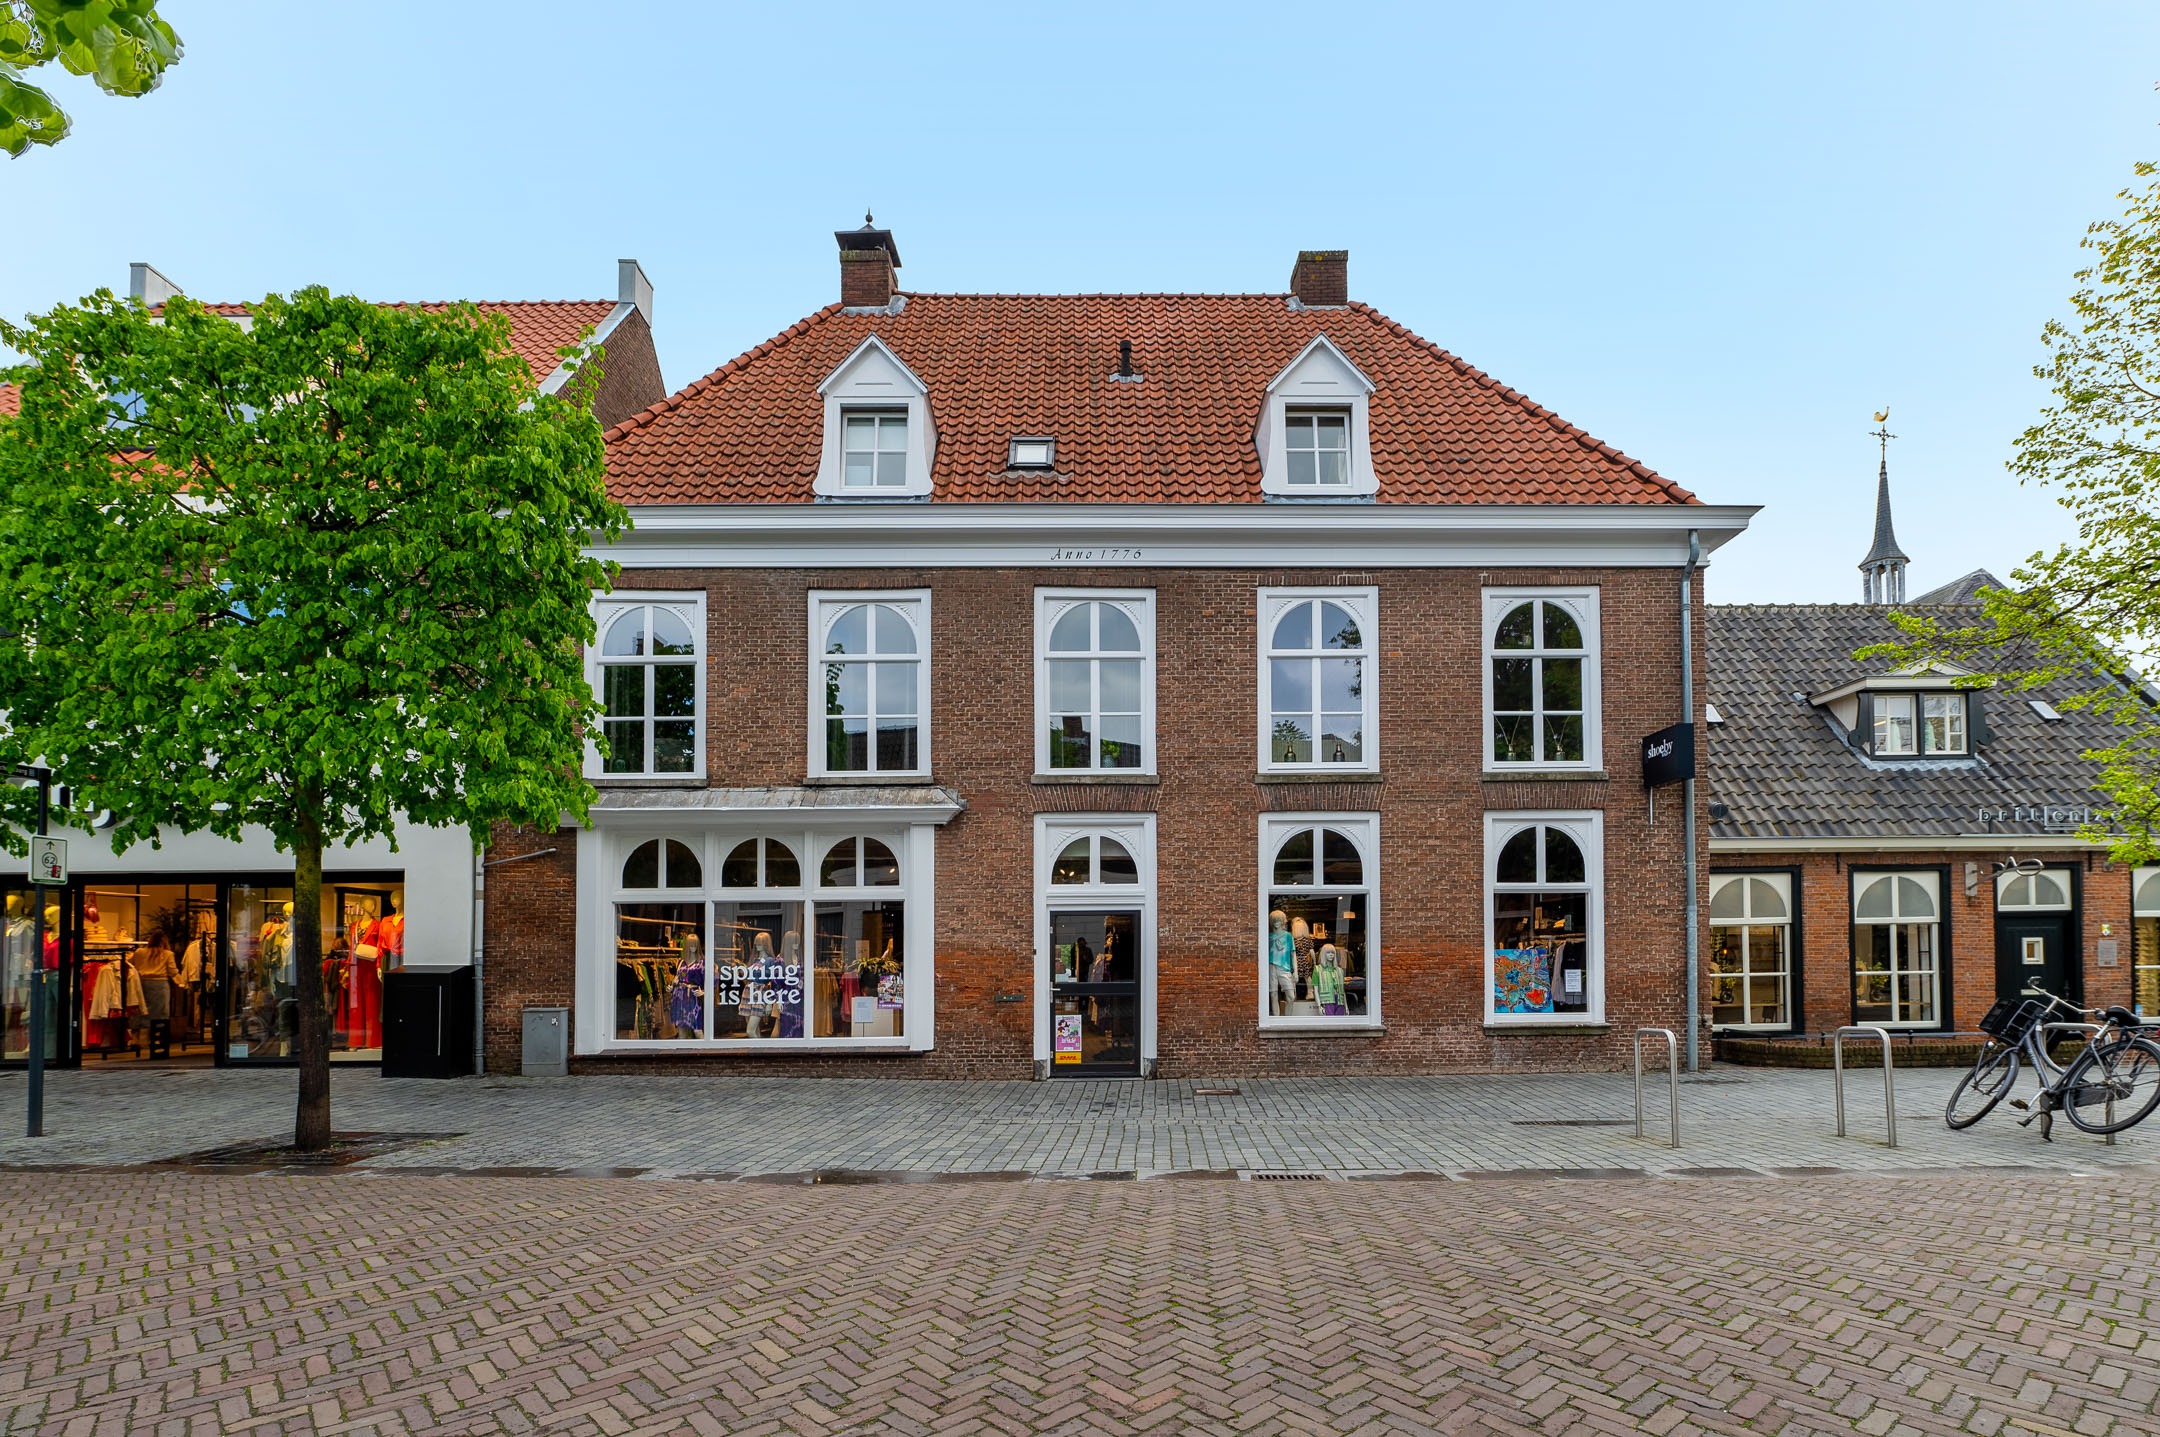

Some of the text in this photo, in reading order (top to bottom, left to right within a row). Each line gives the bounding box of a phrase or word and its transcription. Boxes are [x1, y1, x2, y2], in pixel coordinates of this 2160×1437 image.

[1051, 548, 1141, 560] Anno 1776
[1648, 739, 1673, 758] shoeby
[45, 856, 56, 864] 62
[720, 958, 800, 987] spring
[719, 981, 801, 1005] is here
